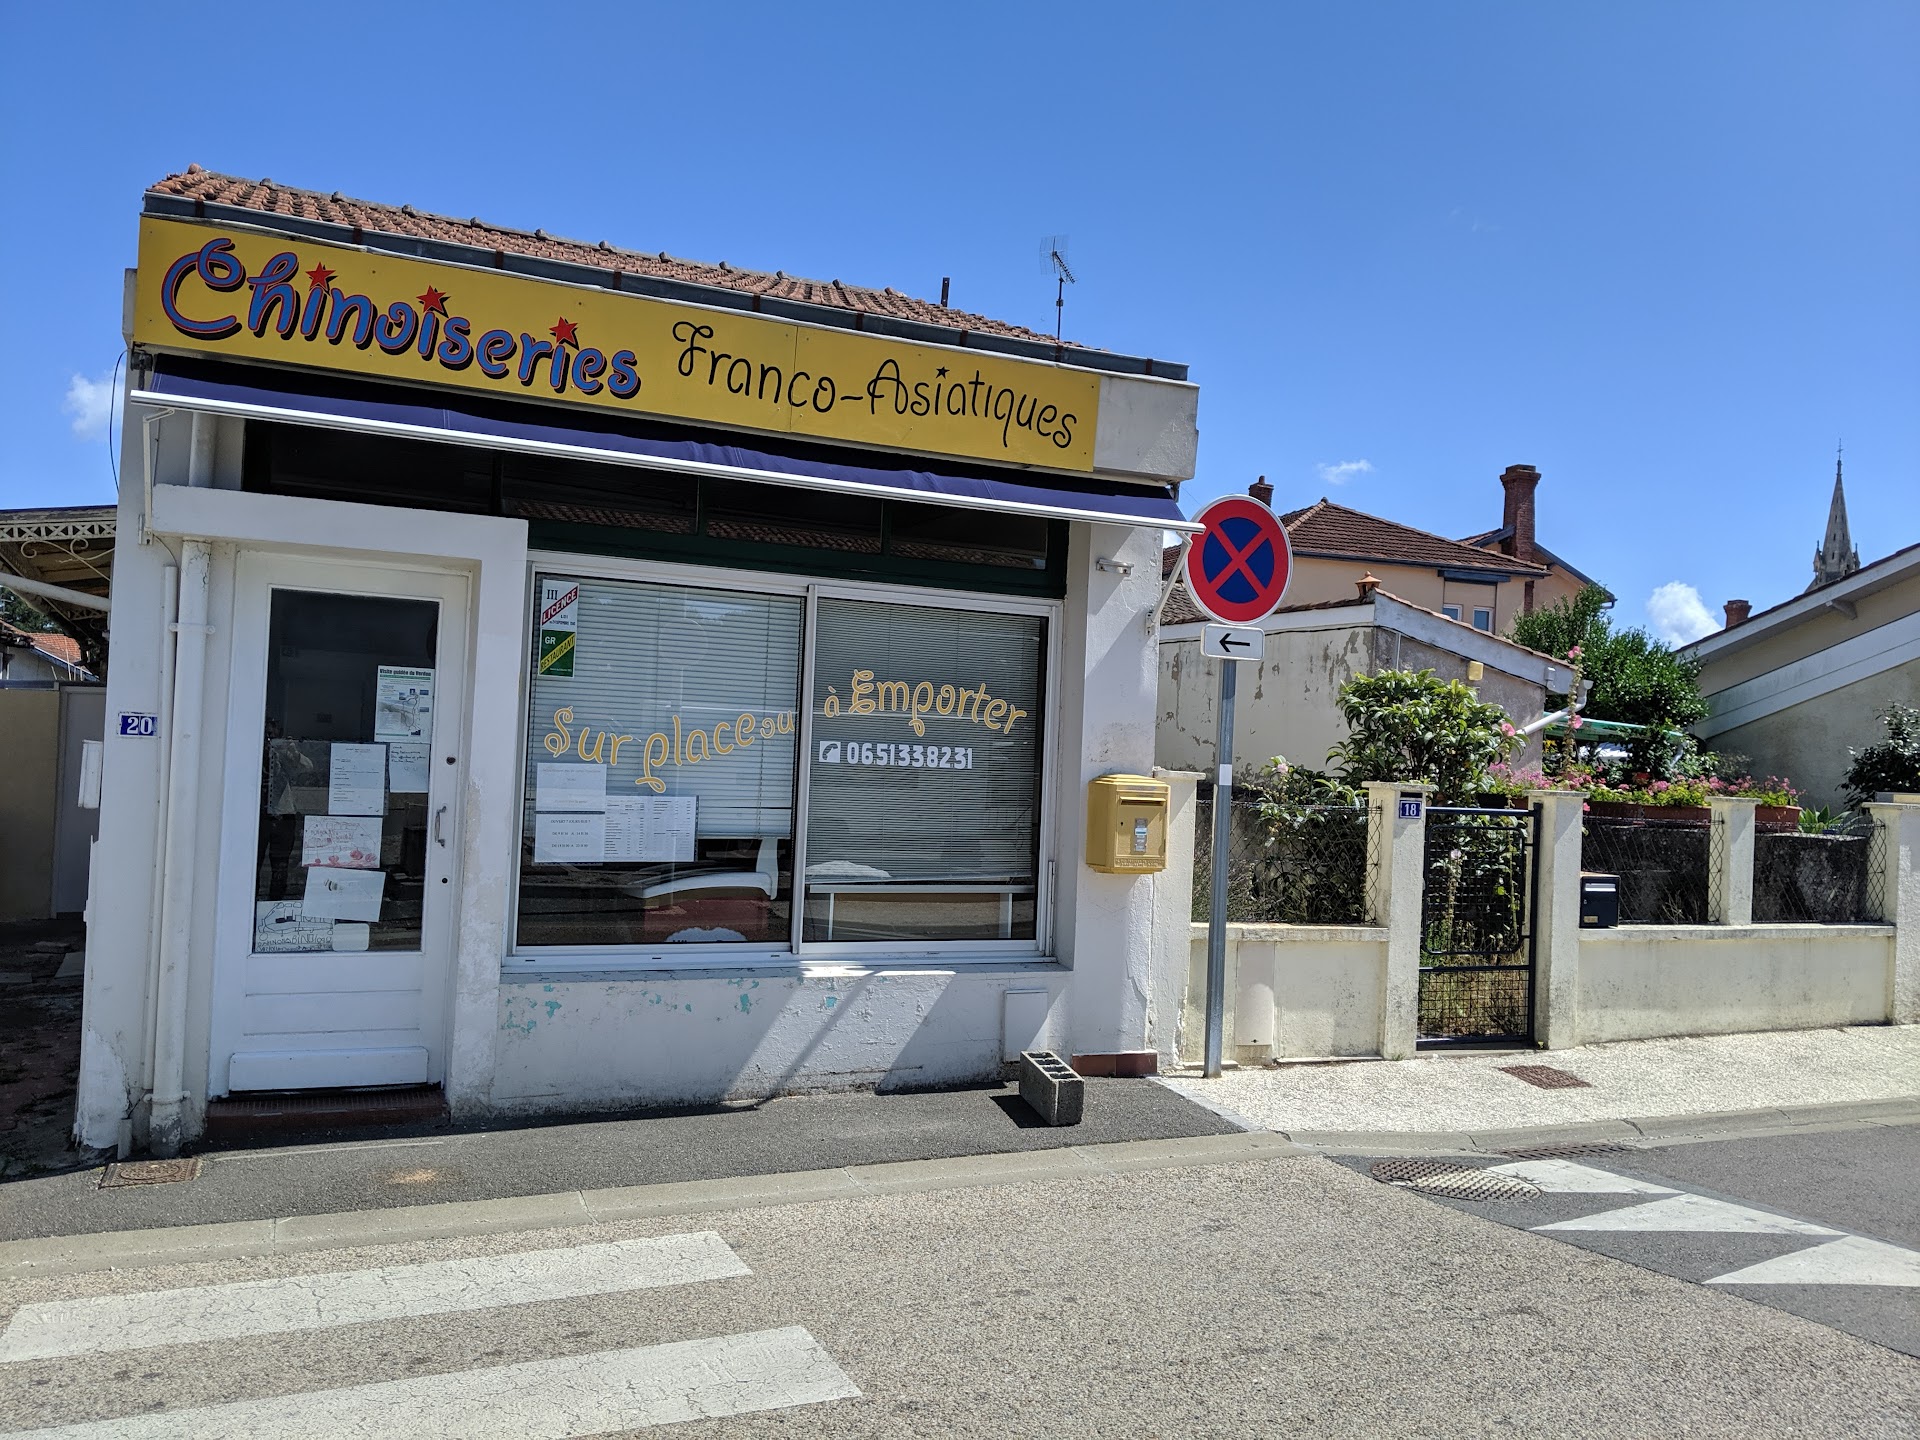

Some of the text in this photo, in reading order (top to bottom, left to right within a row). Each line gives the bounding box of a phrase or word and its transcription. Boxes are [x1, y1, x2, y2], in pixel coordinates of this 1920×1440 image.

[161, 238, 641, 399] Chinoiseries
[672, 321, 1077, 449] Franco-Asiatiques
[543, 588, 577, 622] LICENCE
[547, 589, 558, 600] III
[541, 636, 575, 671] RESTAURANT
[545, 636, 556, 645] GR
[824, 669, 1027, 737] à Emporter
[126, 716, 153, 735] 20
[544, 706, 796, 793] Sur place ou
[1404, 803, 1417, 816] 18
